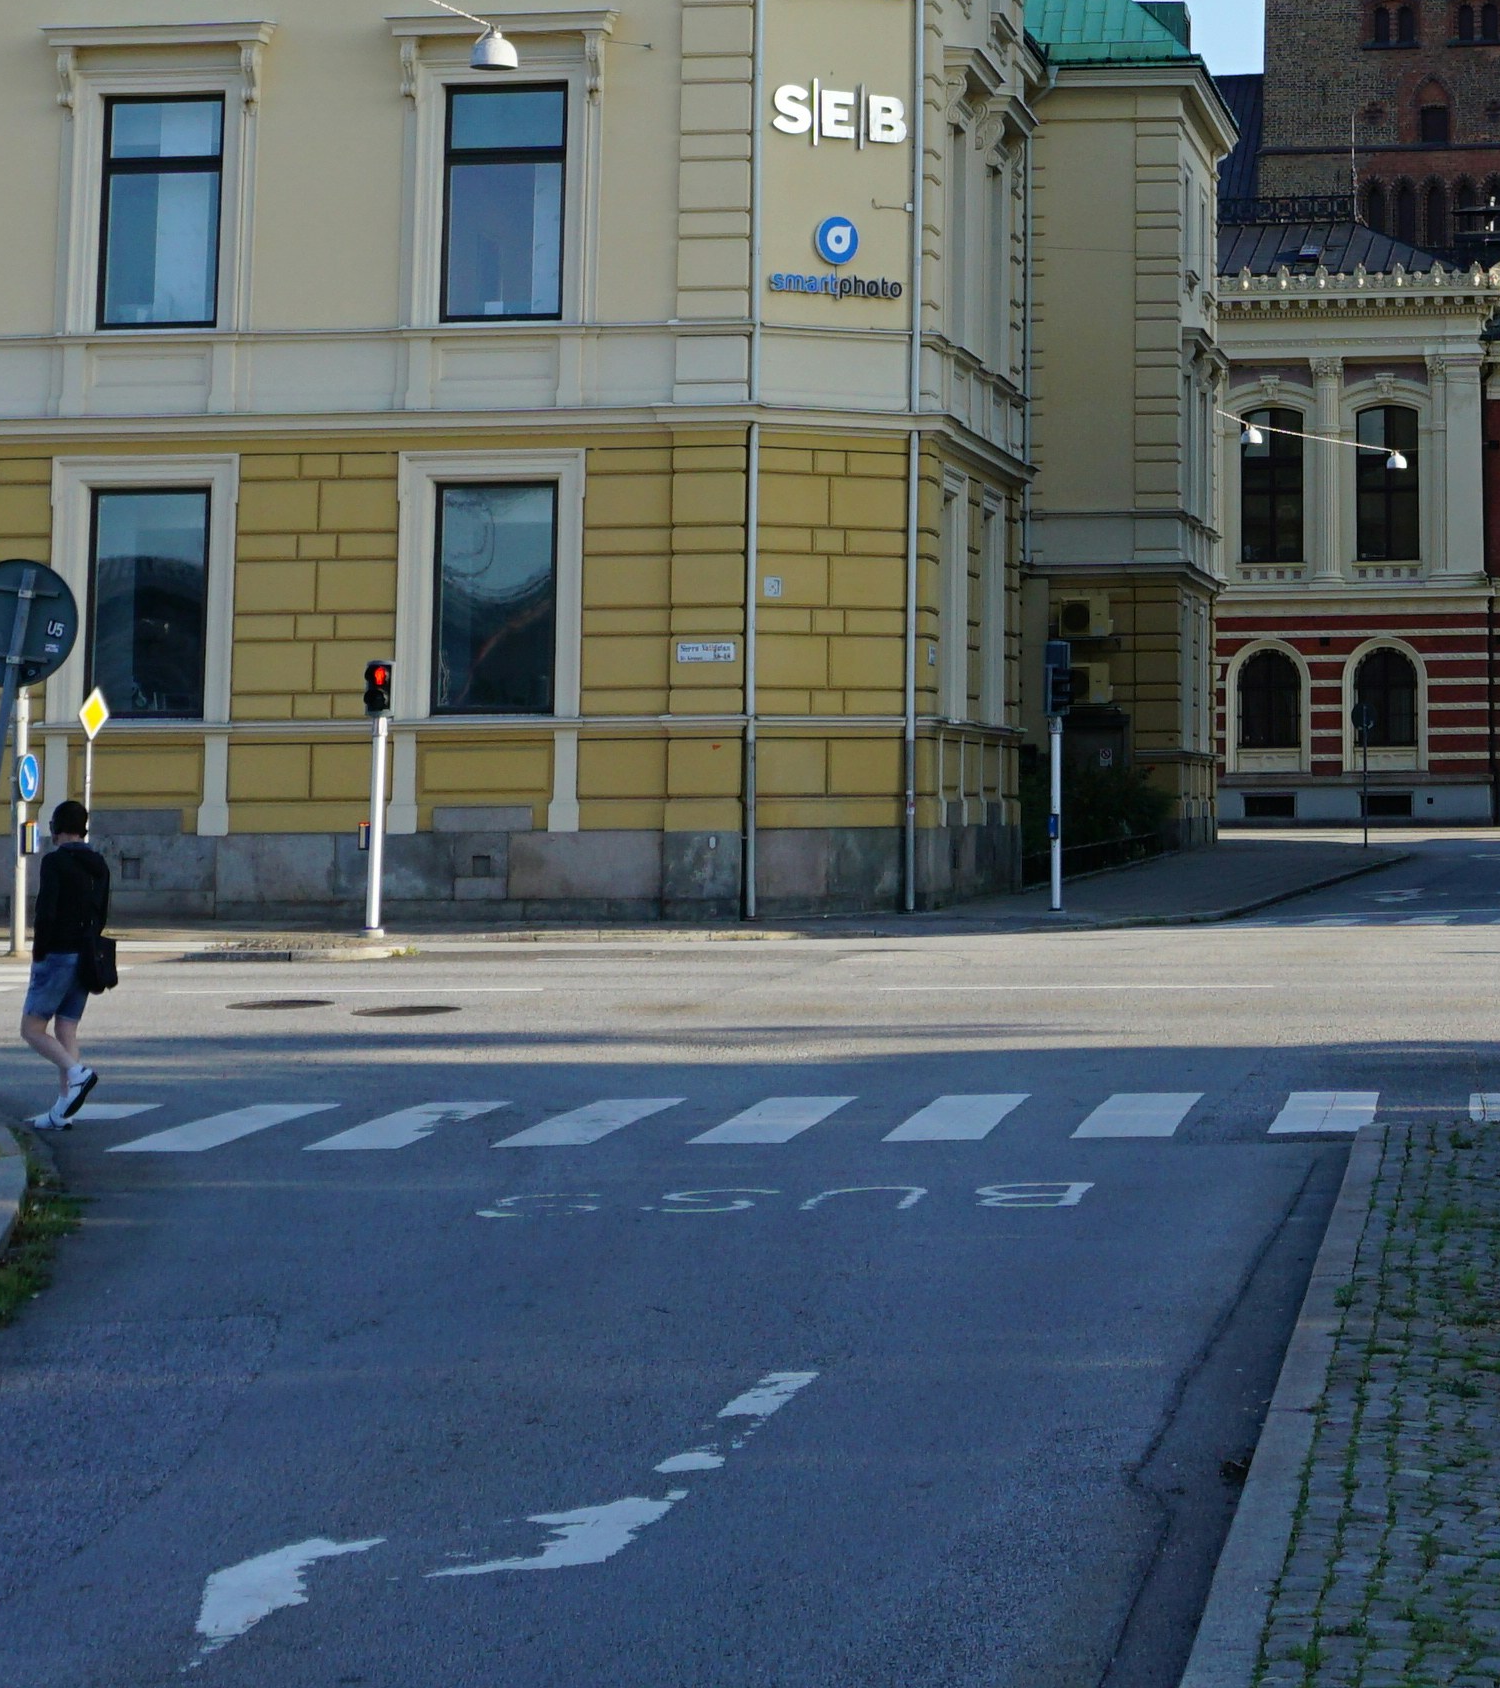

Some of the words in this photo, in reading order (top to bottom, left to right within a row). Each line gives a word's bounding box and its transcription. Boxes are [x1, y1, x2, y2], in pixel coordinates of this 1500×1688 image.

[772, 78, 908, 150] SEB
[769, 270, 903, 300] smartphoto
[47, 620, 65, 638] U5
